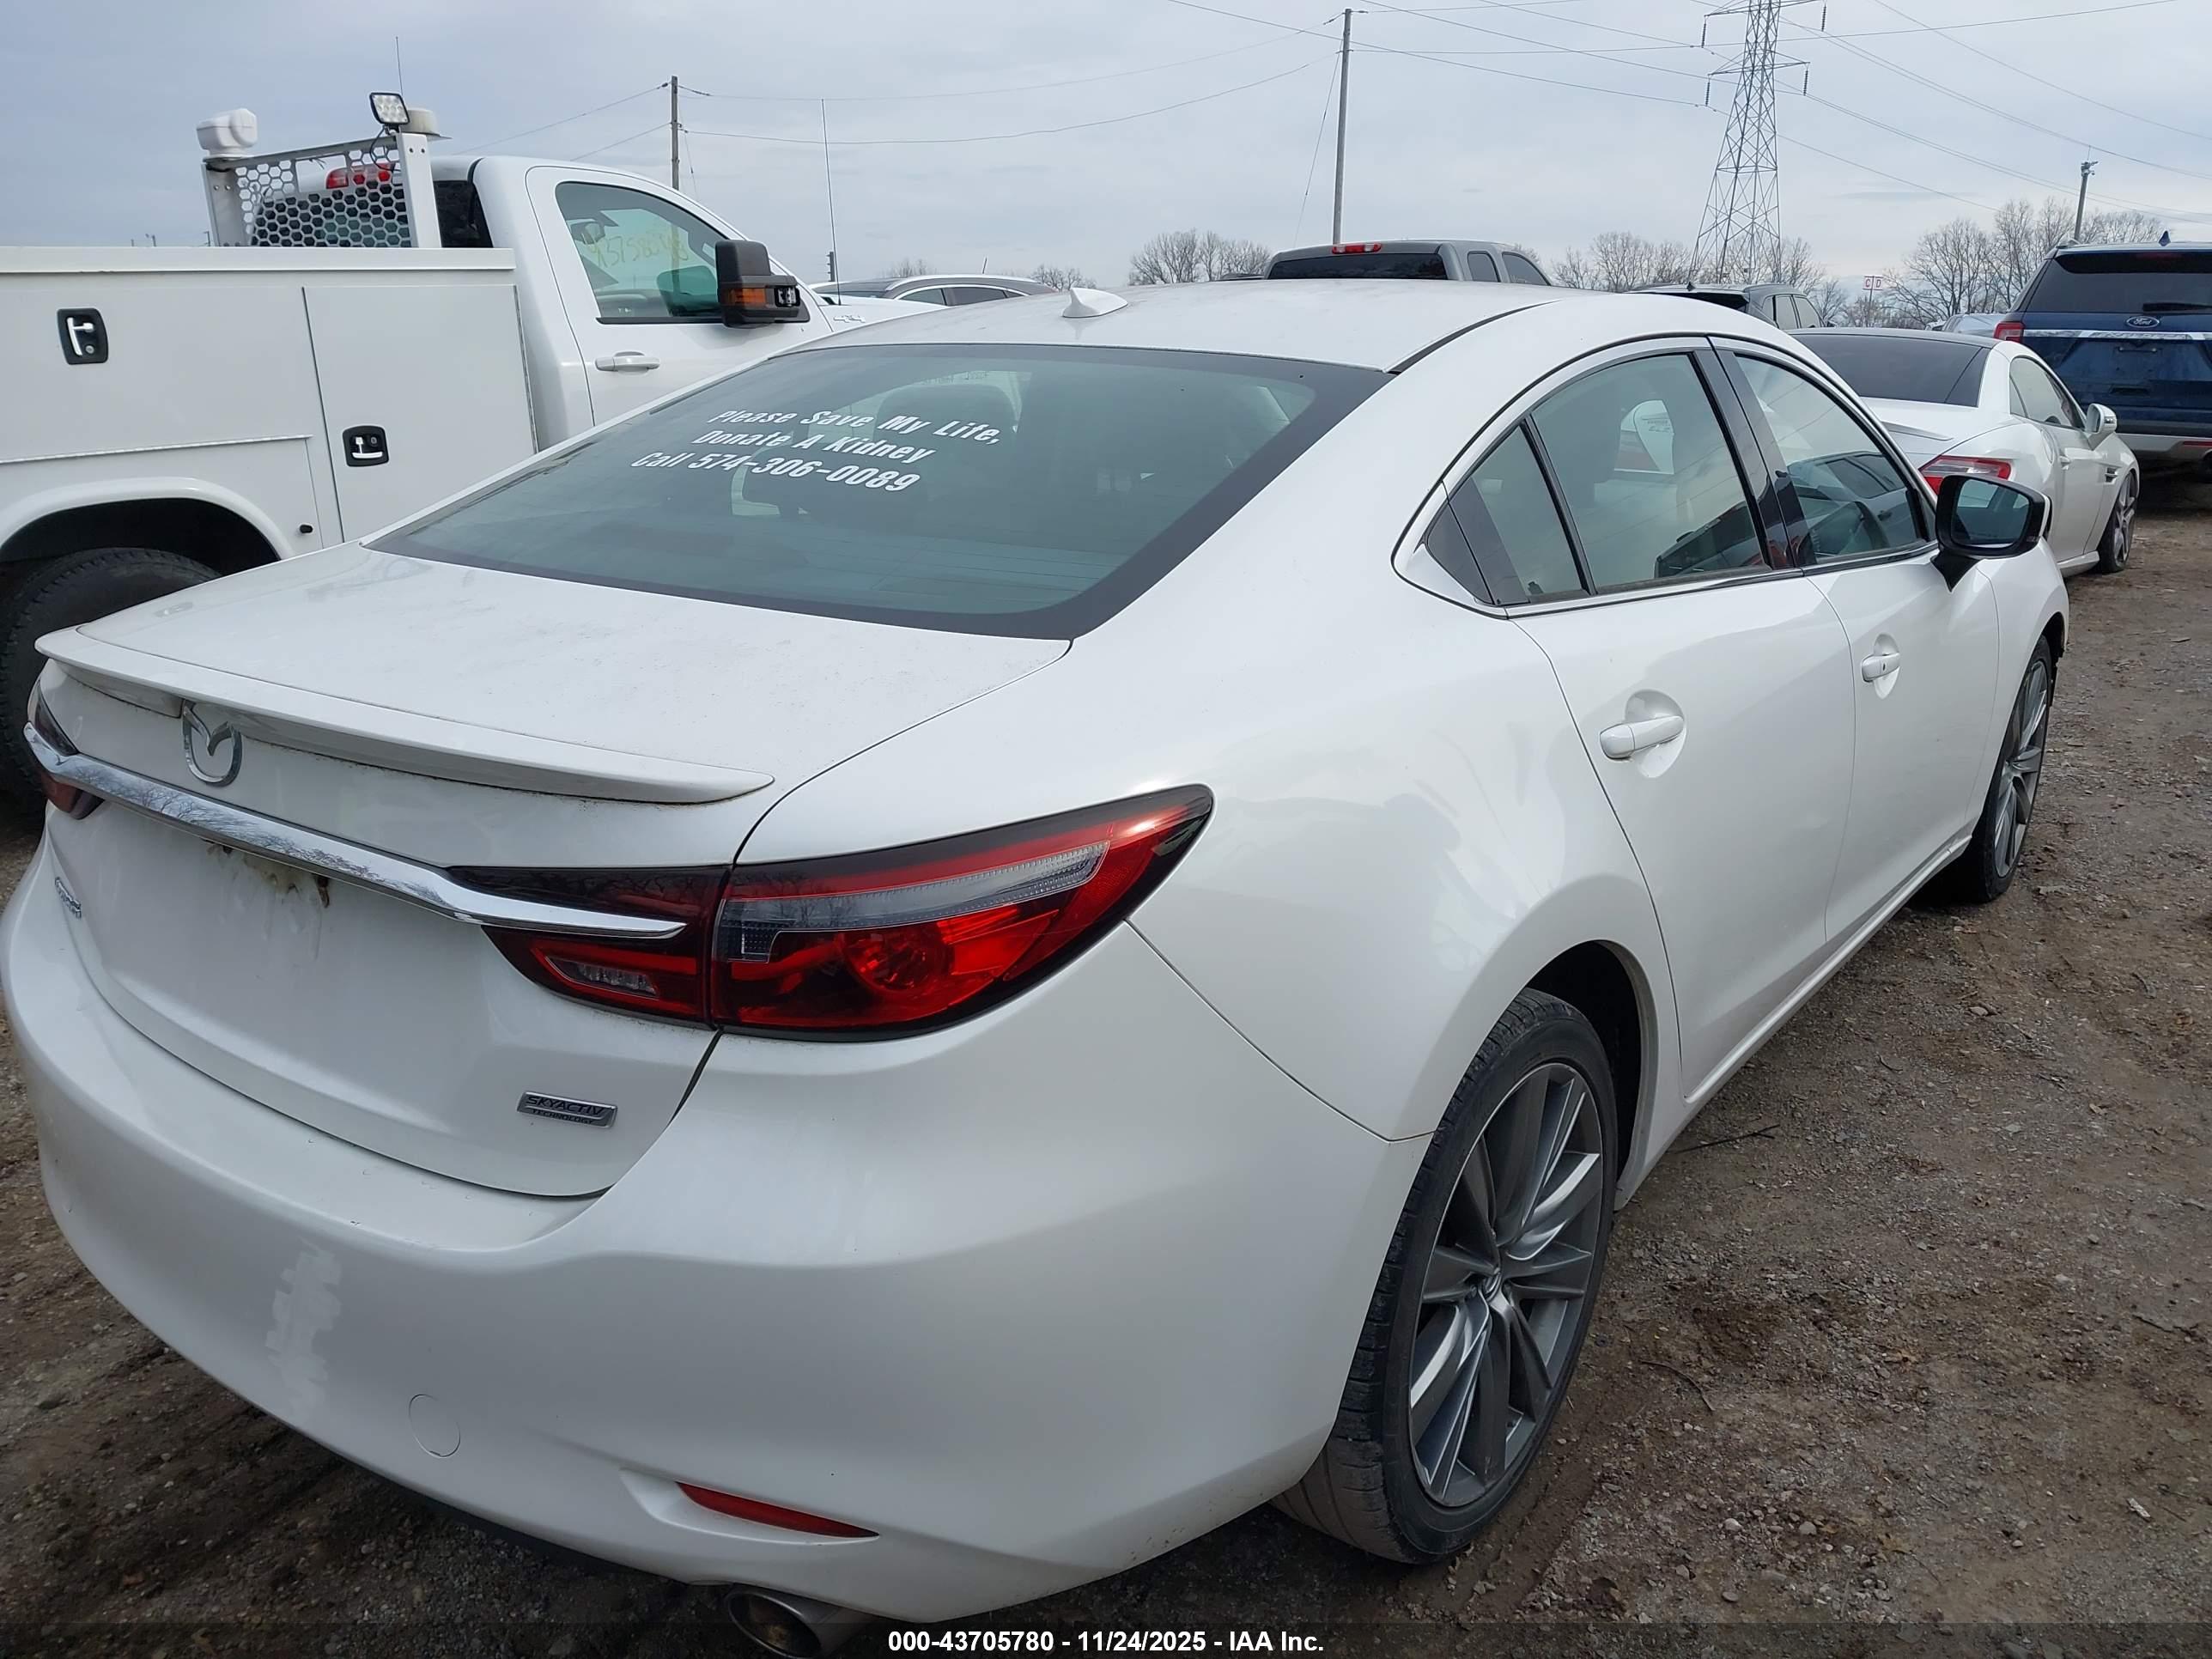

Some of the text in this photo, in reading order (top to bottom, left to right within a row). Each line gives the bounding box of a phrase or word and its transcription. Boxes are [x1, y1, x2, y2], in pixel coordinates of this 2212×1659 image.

[707, 410, 1000, 445] Please Save My Life,
[690, 430, 937, 464] Donate A Kidney
[630, 452, 921, 491] Call 574-306-0089
[527, 1096, 605, 1115] SKYACTIV
[532, 1109, 593, 1125] TECHNOLOGY
